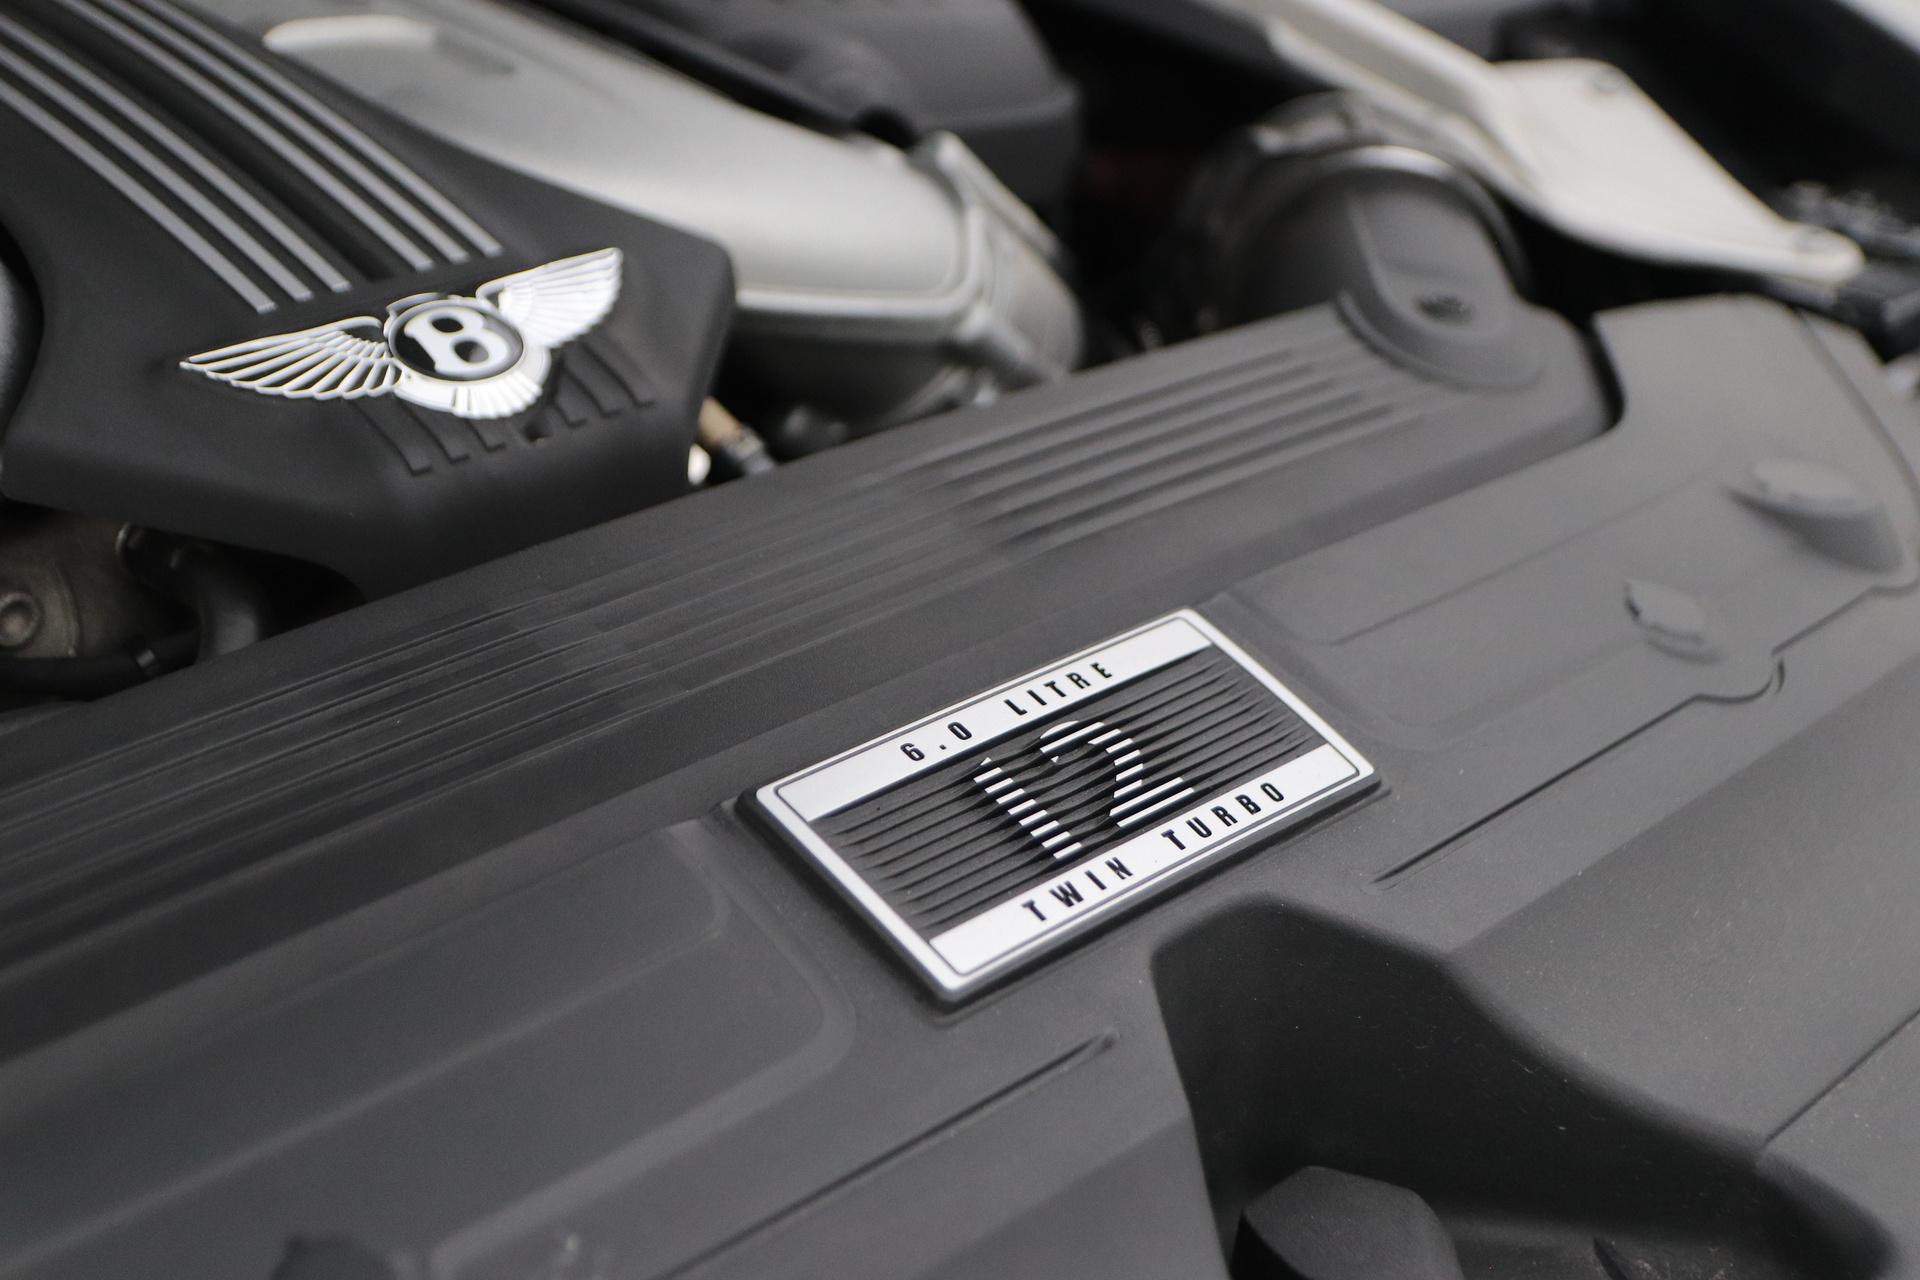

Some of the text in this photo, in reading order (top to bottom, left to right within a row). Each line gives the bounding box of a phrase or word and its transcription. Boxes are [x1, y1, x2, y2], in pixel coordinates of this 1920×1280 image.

[900, 662, 1113, 762] 6.0 LITRE
[973, 720, 1195, 860] 12
[1021, 781, 1285, 922] TWIN TURBO
